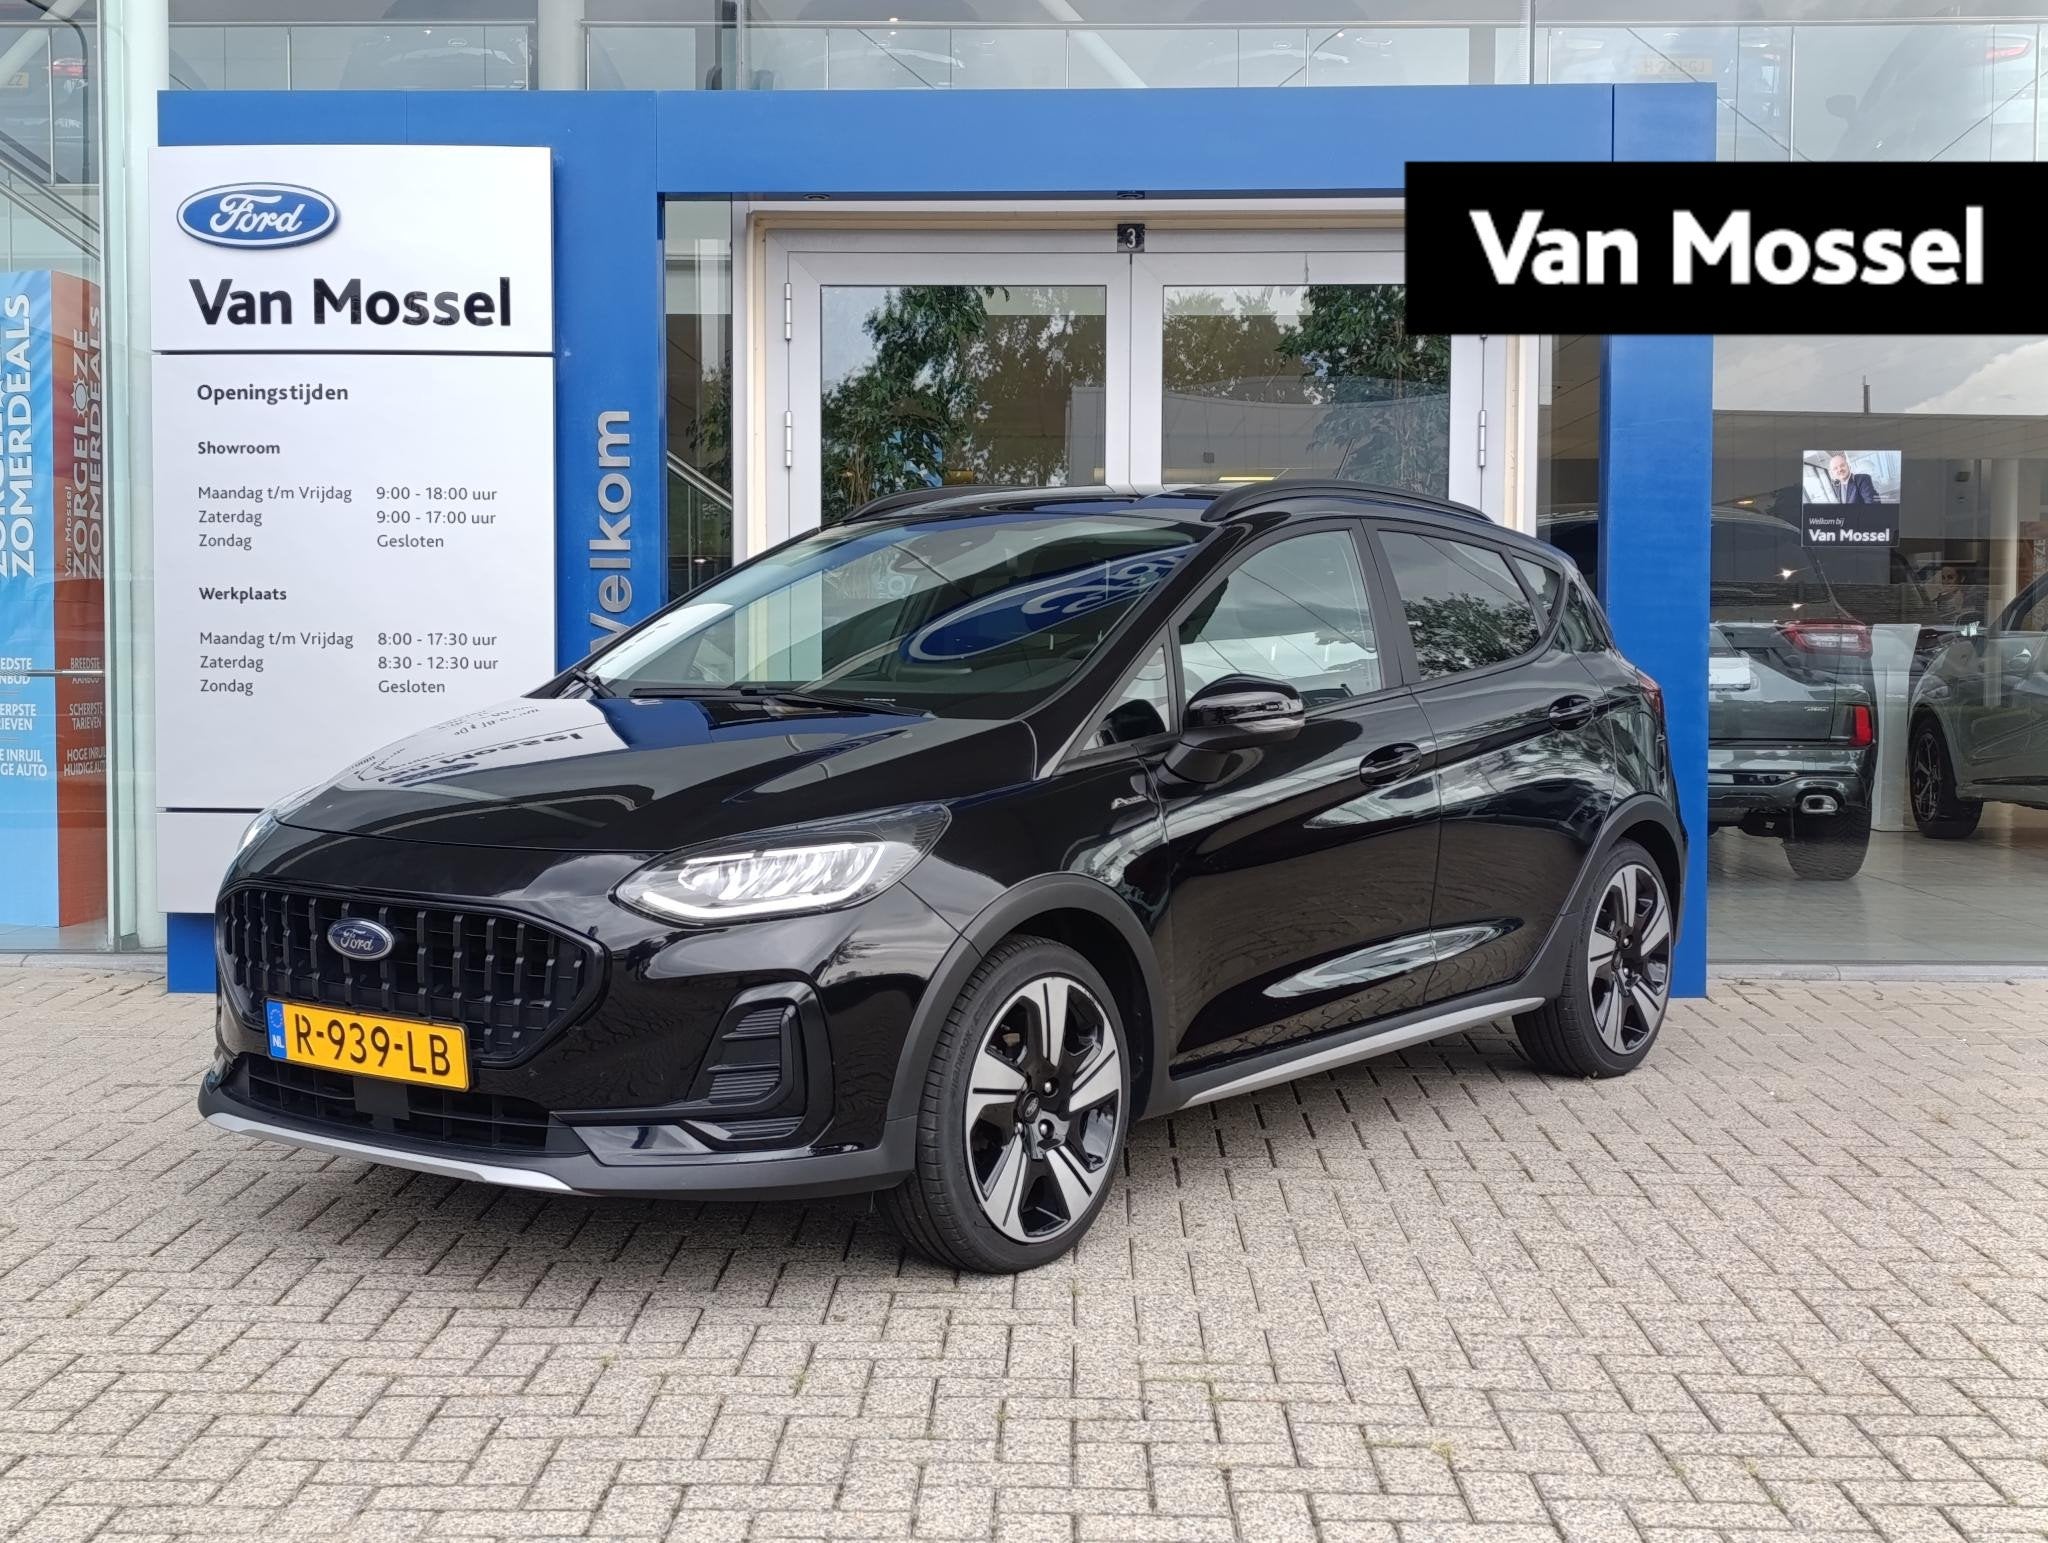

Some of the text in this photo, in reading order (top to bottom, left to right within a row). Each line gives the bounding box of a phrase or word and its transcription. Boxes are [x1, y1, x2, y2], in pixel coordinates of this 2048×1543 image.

[209, 193, 306, 233] Ford
[1126, 227, 1137, 249] 3
[188, 276, 512, 327] Van Mossel
[196, 382, 349, 406] Openingstijden
[4, 294, 36, 578] ZOMERDEALS
[89, 306, 102, 579] ZOMERDEALS
[197, 440, 281, 455] Showroom
[198, 485, 353, 504] Maandag t/m Vrijdag
[375, 486, 411, 501] 9:00
[425, 486, 468, 501] 18:00
[472, 490, 498, 501] uur
[198, 509, 263, 528] Zaterdag
[376, 510, 411, 525] 9:00
[425, 510, 467, 525] 17:00
[471, 514, 497, 525] uur
[198, 533, 253, 552] Zondag
[376, 533, 444, 548] Gesloten
[1808, 527, 1890, 542] Van Mossel
[198, 586, 287, 605] Werkplaats
[199, 631, 354, 650] Maandag t/m Vrijdag
[377, 632, 413, 646] 8:00
[427, 632, 468, 646] 17:30
[472, 636, 498, 646] uur
[199, 654, 264, 673] Zaterdag
[377, 655, 413, 670] 8:30
[426, 656, 470, 670] 12:30
[473, 659, 499, 670] uur
[199, 678, 254, 697] Zondag
[377, 679, 446, 694] Gesloten
[7, 748, 43, 762] INRUIL
[66, 748, 88, 762] HOGE
[16, 763, 48, 777] AUTO
[339, 928, 375, 953] Ford
[272, 1034, 286, 1049] NL
[294, 1013, 451, 1077] R-939-LB
